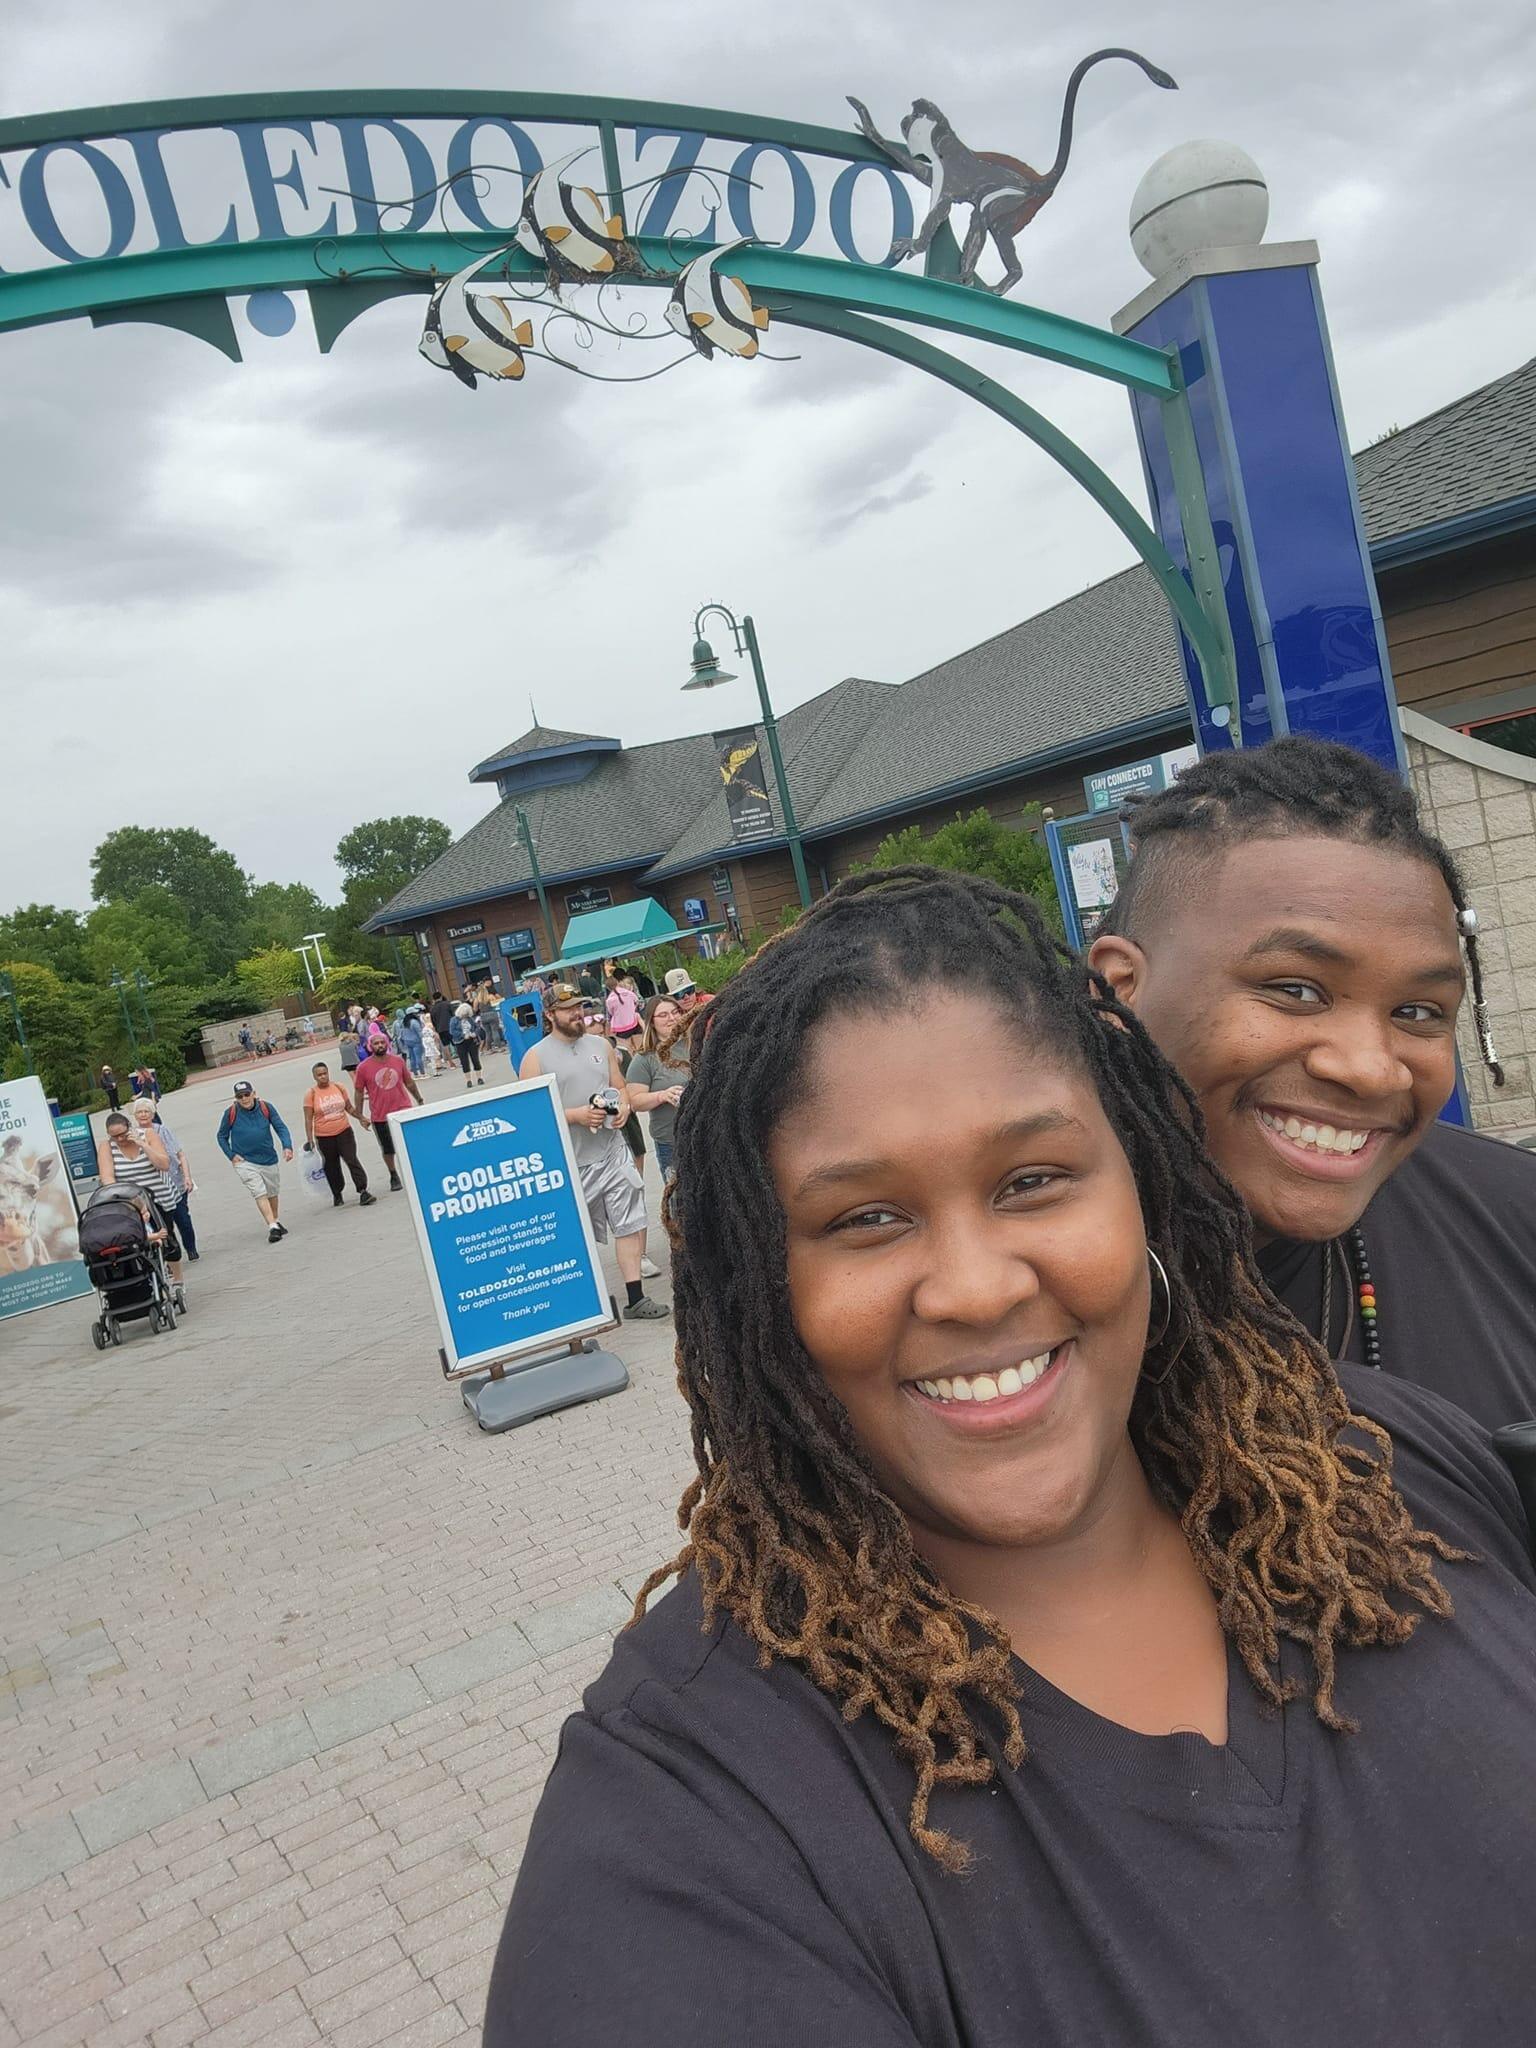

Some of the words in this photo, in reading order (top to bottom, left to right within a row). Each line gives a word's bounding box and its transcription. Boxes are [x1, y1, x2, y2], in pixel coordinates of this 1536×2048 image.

[634, 126, 914, 269] ZOO
[1090, 777, 1107, 792] STAY
[1106, 763, 1153, 788] CONNECTED
[472, 1123, 495, 1138] ZOO
[442, 1152, 545, 1196] COOLERS
[430, 1169, 565, 1222] PROHIBITED
[455, 1231, 487, 1246] Please
[488, 1224, 508, 1236] visit
[509, 1219, 527, 1230] one
[529, 1215, 539, 1225] of
[540, 1211, 556, 1221] our
[459, 1234, 511, 1256] concession
[512, 1225, 543, 1241] stands
[544, 1221, 557, 1231] for
[465, 1251, 488, 1265] food
[489, 1246, 507, 1258] and
[508, 1232, 557, 1252] beverages
[458, 1258, 578, 1301] TOLEDOZOO.ORG/MAP
[505, 1263, 527, 1275] Visit
[457, 1303, 471, 1313] for
[472, 1296, 496, 1310] open
[497, 1280, 550, 1302] concessions
[550, 1269, 584, 1286] options
[502, 1305, 533, 1321] Thank
[532, 1300, 551, 1314] you
